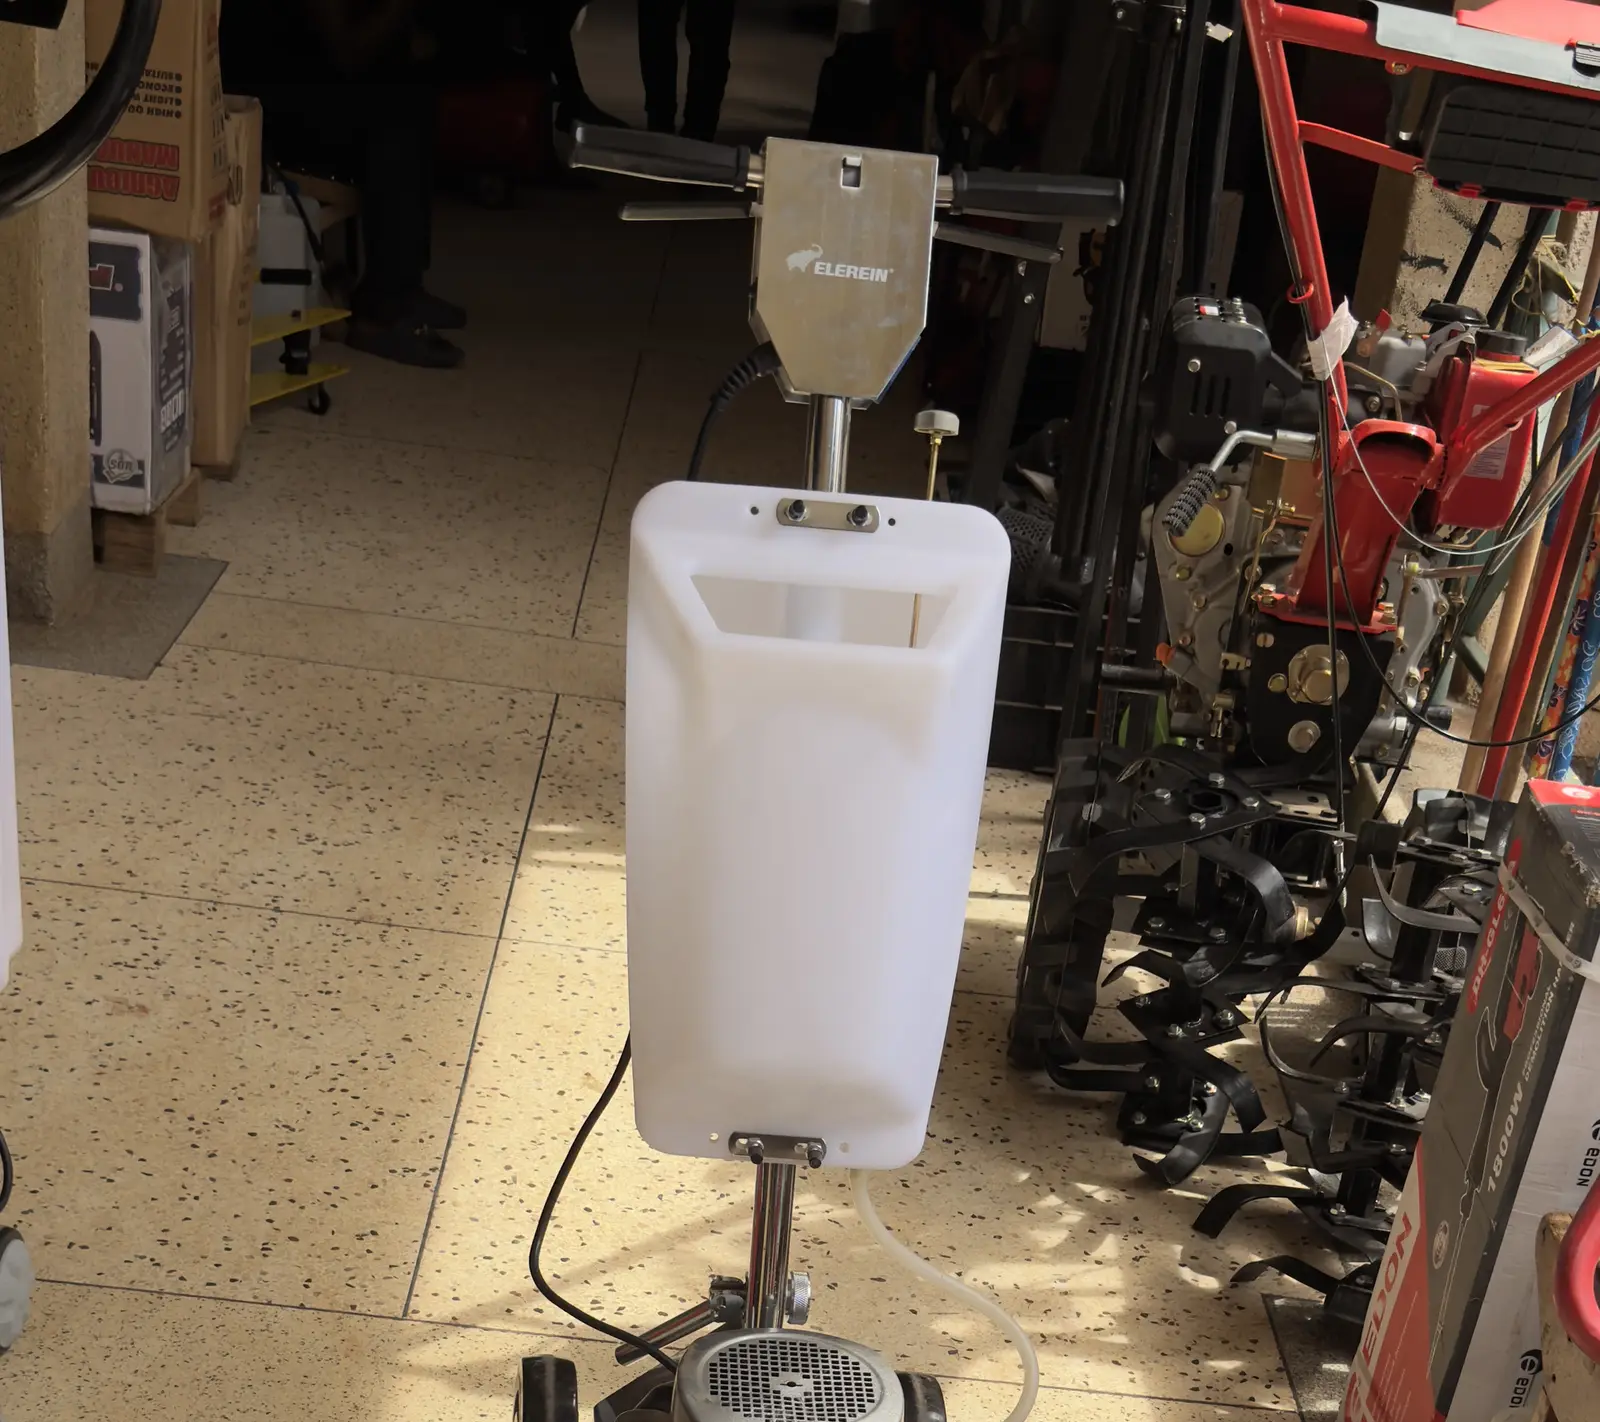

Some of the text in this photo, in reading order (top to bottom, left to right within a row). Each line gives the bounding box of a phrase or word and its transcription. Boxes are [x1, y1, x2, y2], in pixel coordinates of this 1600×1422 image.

[814, 261, 888, 283] ELEREIN
[1524, 990, 1555, 1082] DEMOLITION
[1487, 1081, 1523, 1192] 1800W
[1363, 1211, 1413, 1366] EDON
